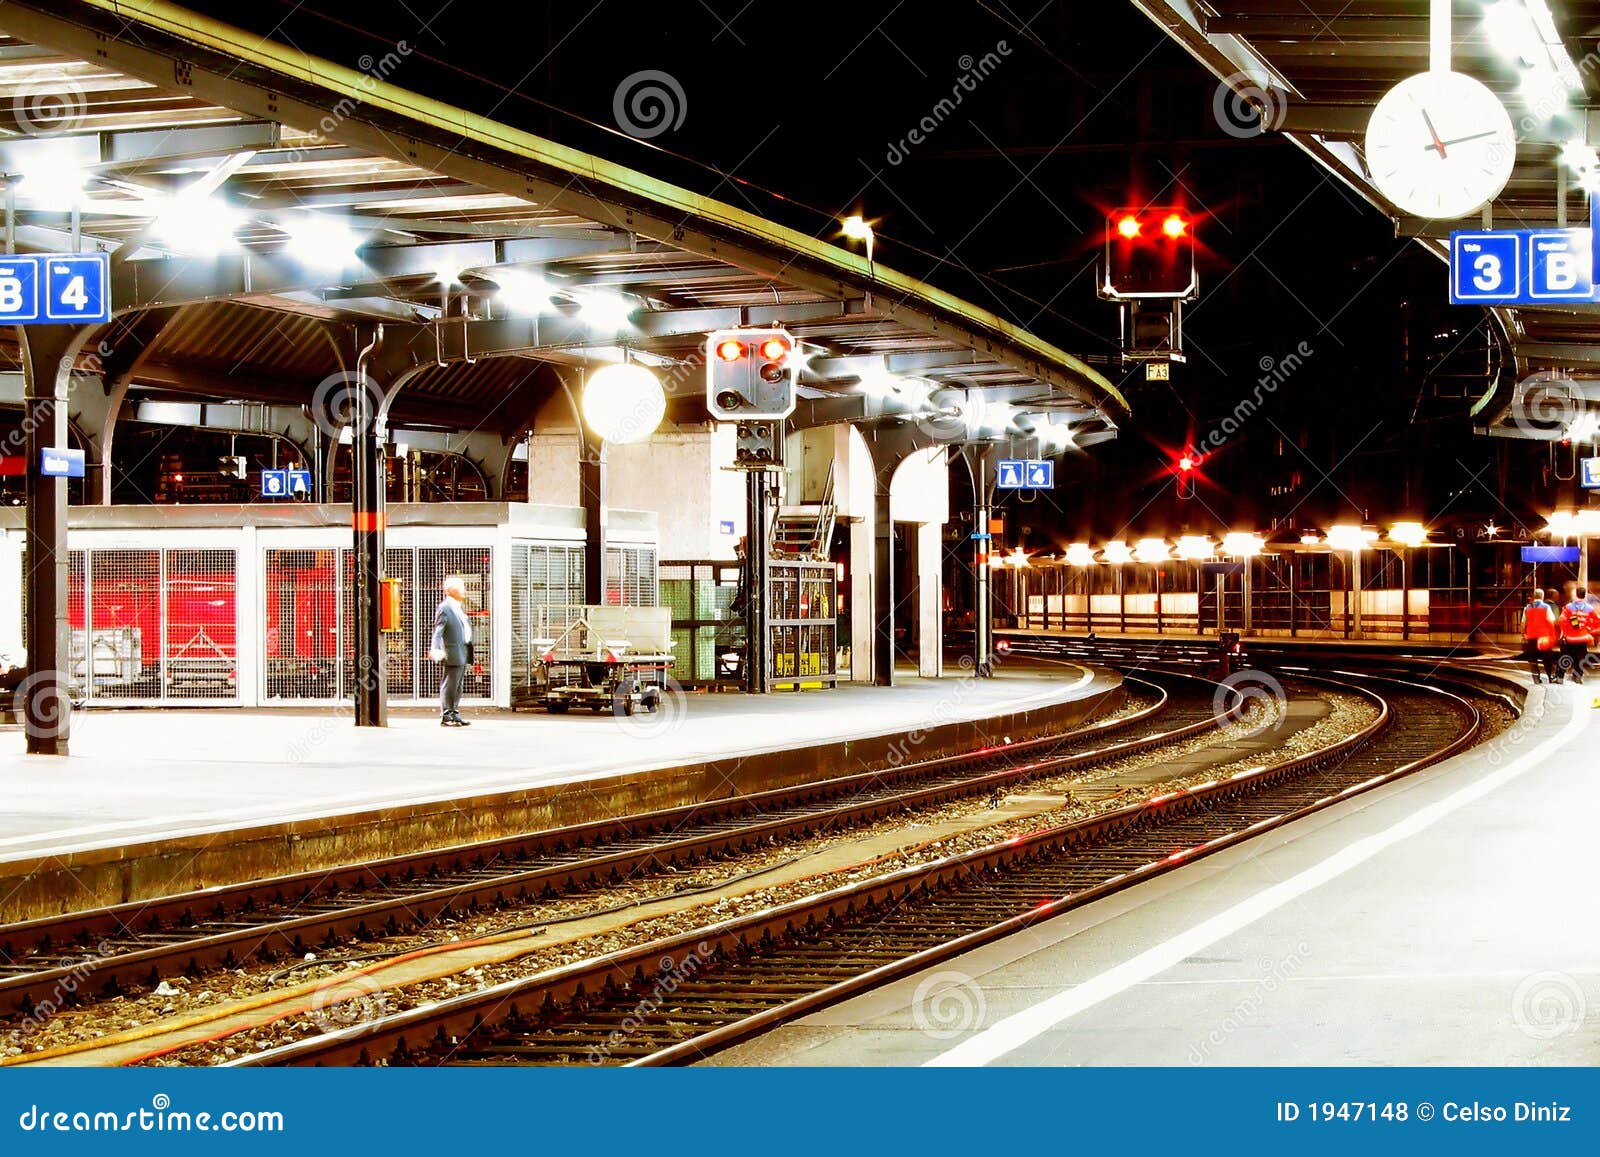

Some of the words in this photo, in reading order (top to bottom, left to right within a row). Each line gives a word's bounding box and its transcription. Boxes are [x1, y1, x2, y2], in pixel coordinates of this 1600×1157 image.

[1472, 254, 1502, 291] 3
[1546, 252, 1577, 290] B
[0, 277, 23, 312] B
[61, 275, 89, 311] 4
[1004, 468, 1018, 485] A
[1032, 468, 1046, 485] 4
